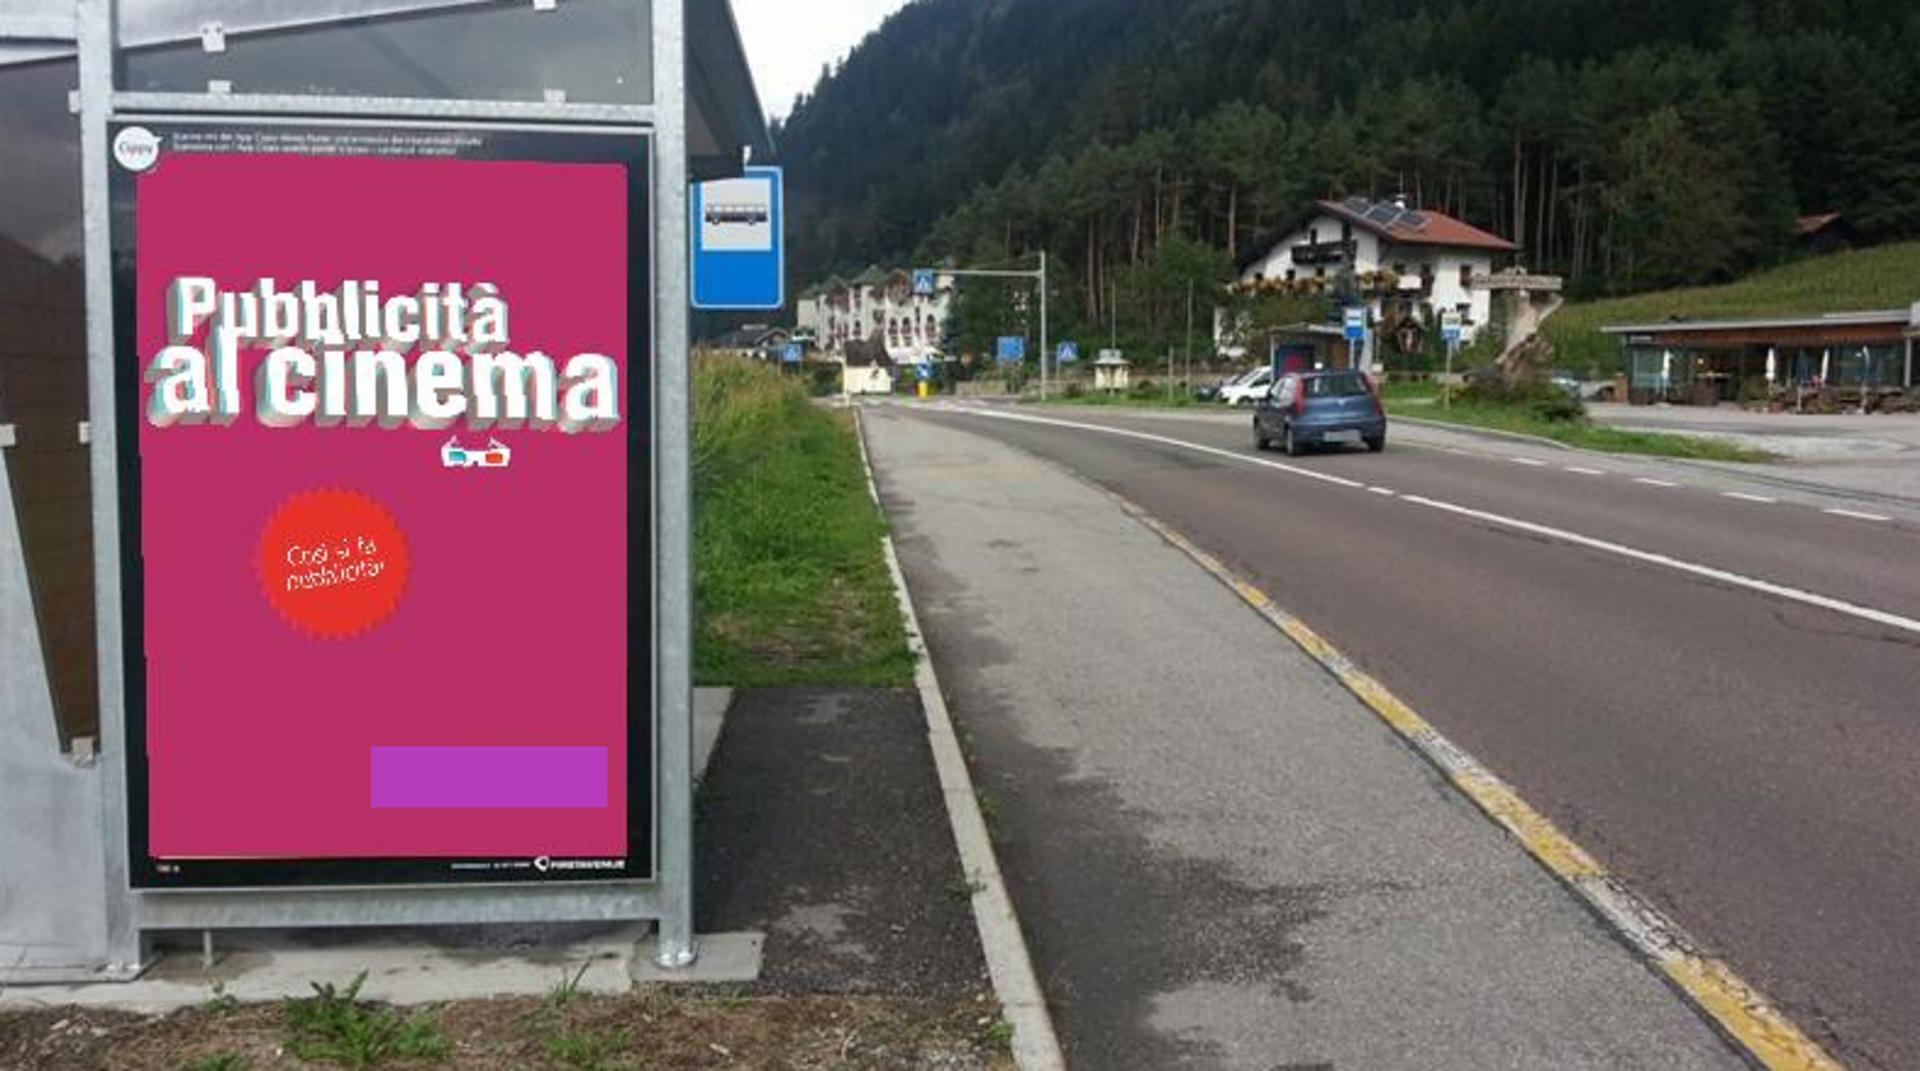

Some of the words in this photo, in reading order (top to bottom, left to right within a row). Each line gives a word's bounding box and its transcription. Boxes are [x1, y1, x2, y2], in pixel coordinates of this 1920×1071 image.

[171, 276, 508, 346] Pubblicità
[148, 326, 241, 424] al
[258, 328, 620, 430] cinema
